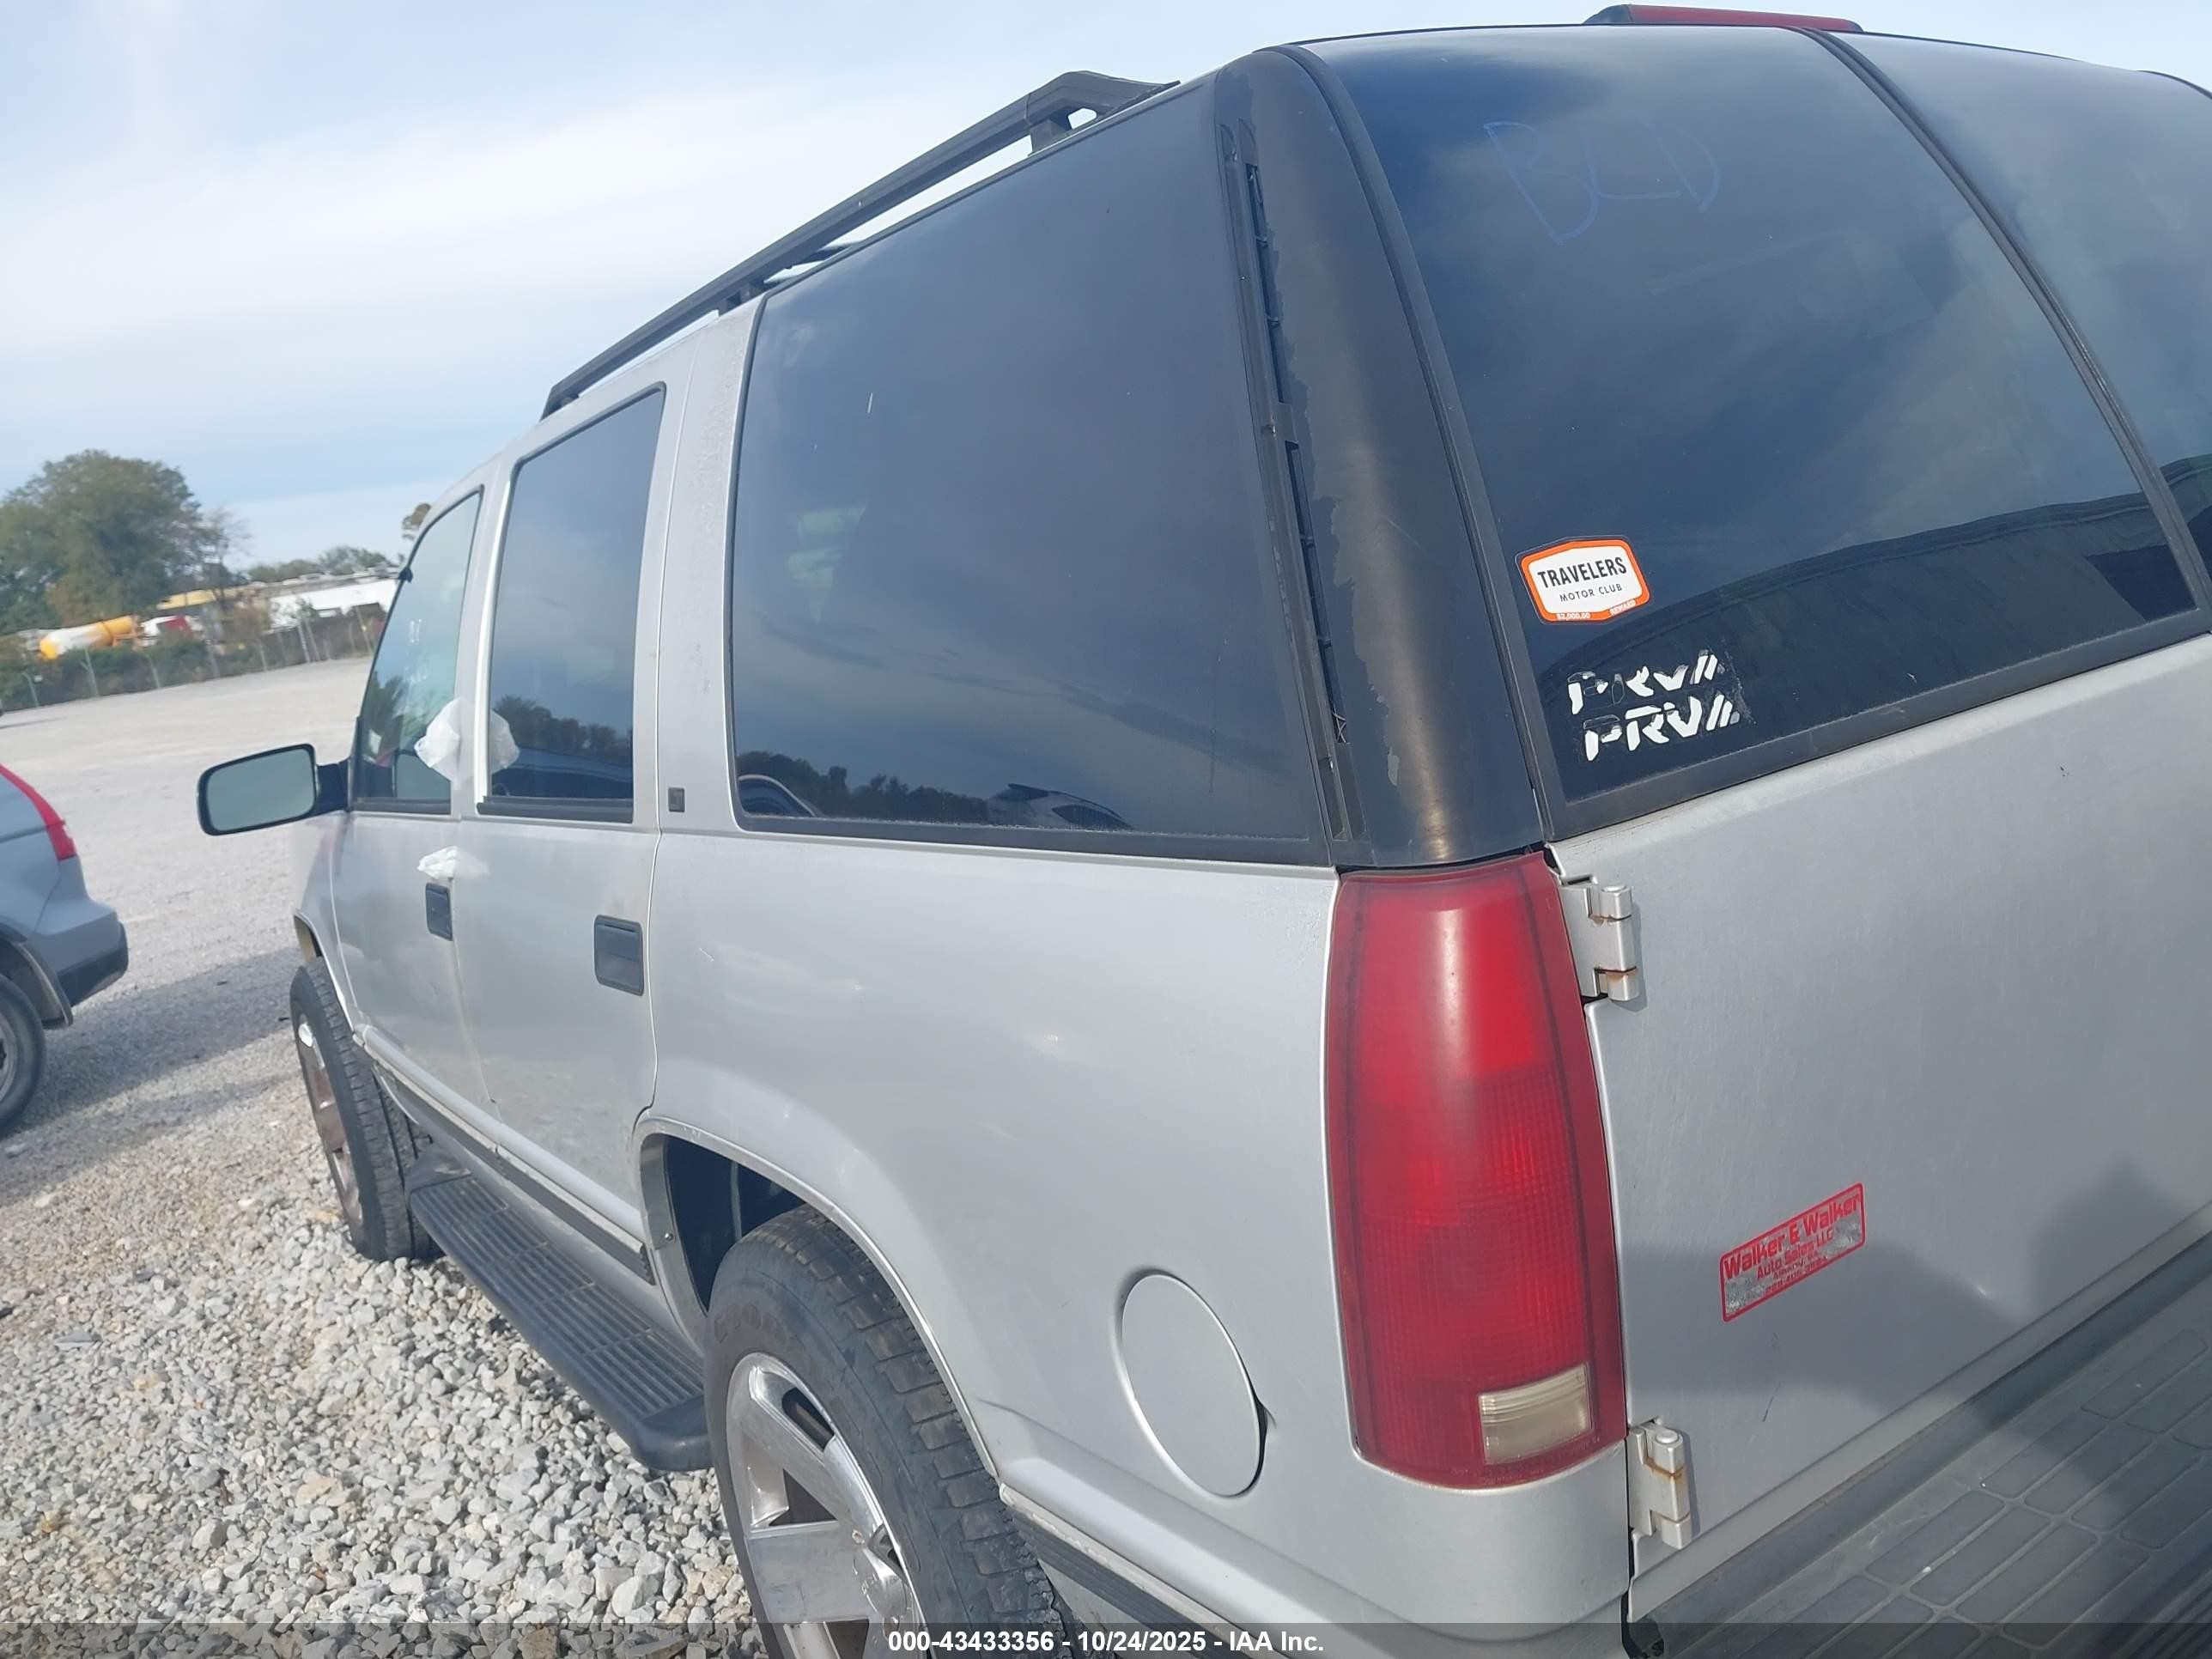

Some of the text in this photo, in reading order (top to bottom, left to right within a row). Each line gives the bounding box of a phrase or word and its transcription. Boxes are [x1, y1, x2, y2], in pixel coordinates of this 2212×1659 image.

[1537, 556, 1627, 589] TRAVELERS
[1559, 583, 1623, 602] MOTOR CLUB
[1609, 599, 1636, 617] REWARD
[1724, 1234, 1787, 1279] Walker
[1803, 1194, 1860, 1237] Walker
[1757, 1258, 1783, 1281] Auto
[1816, 1227, 1834, 1248] LLC
